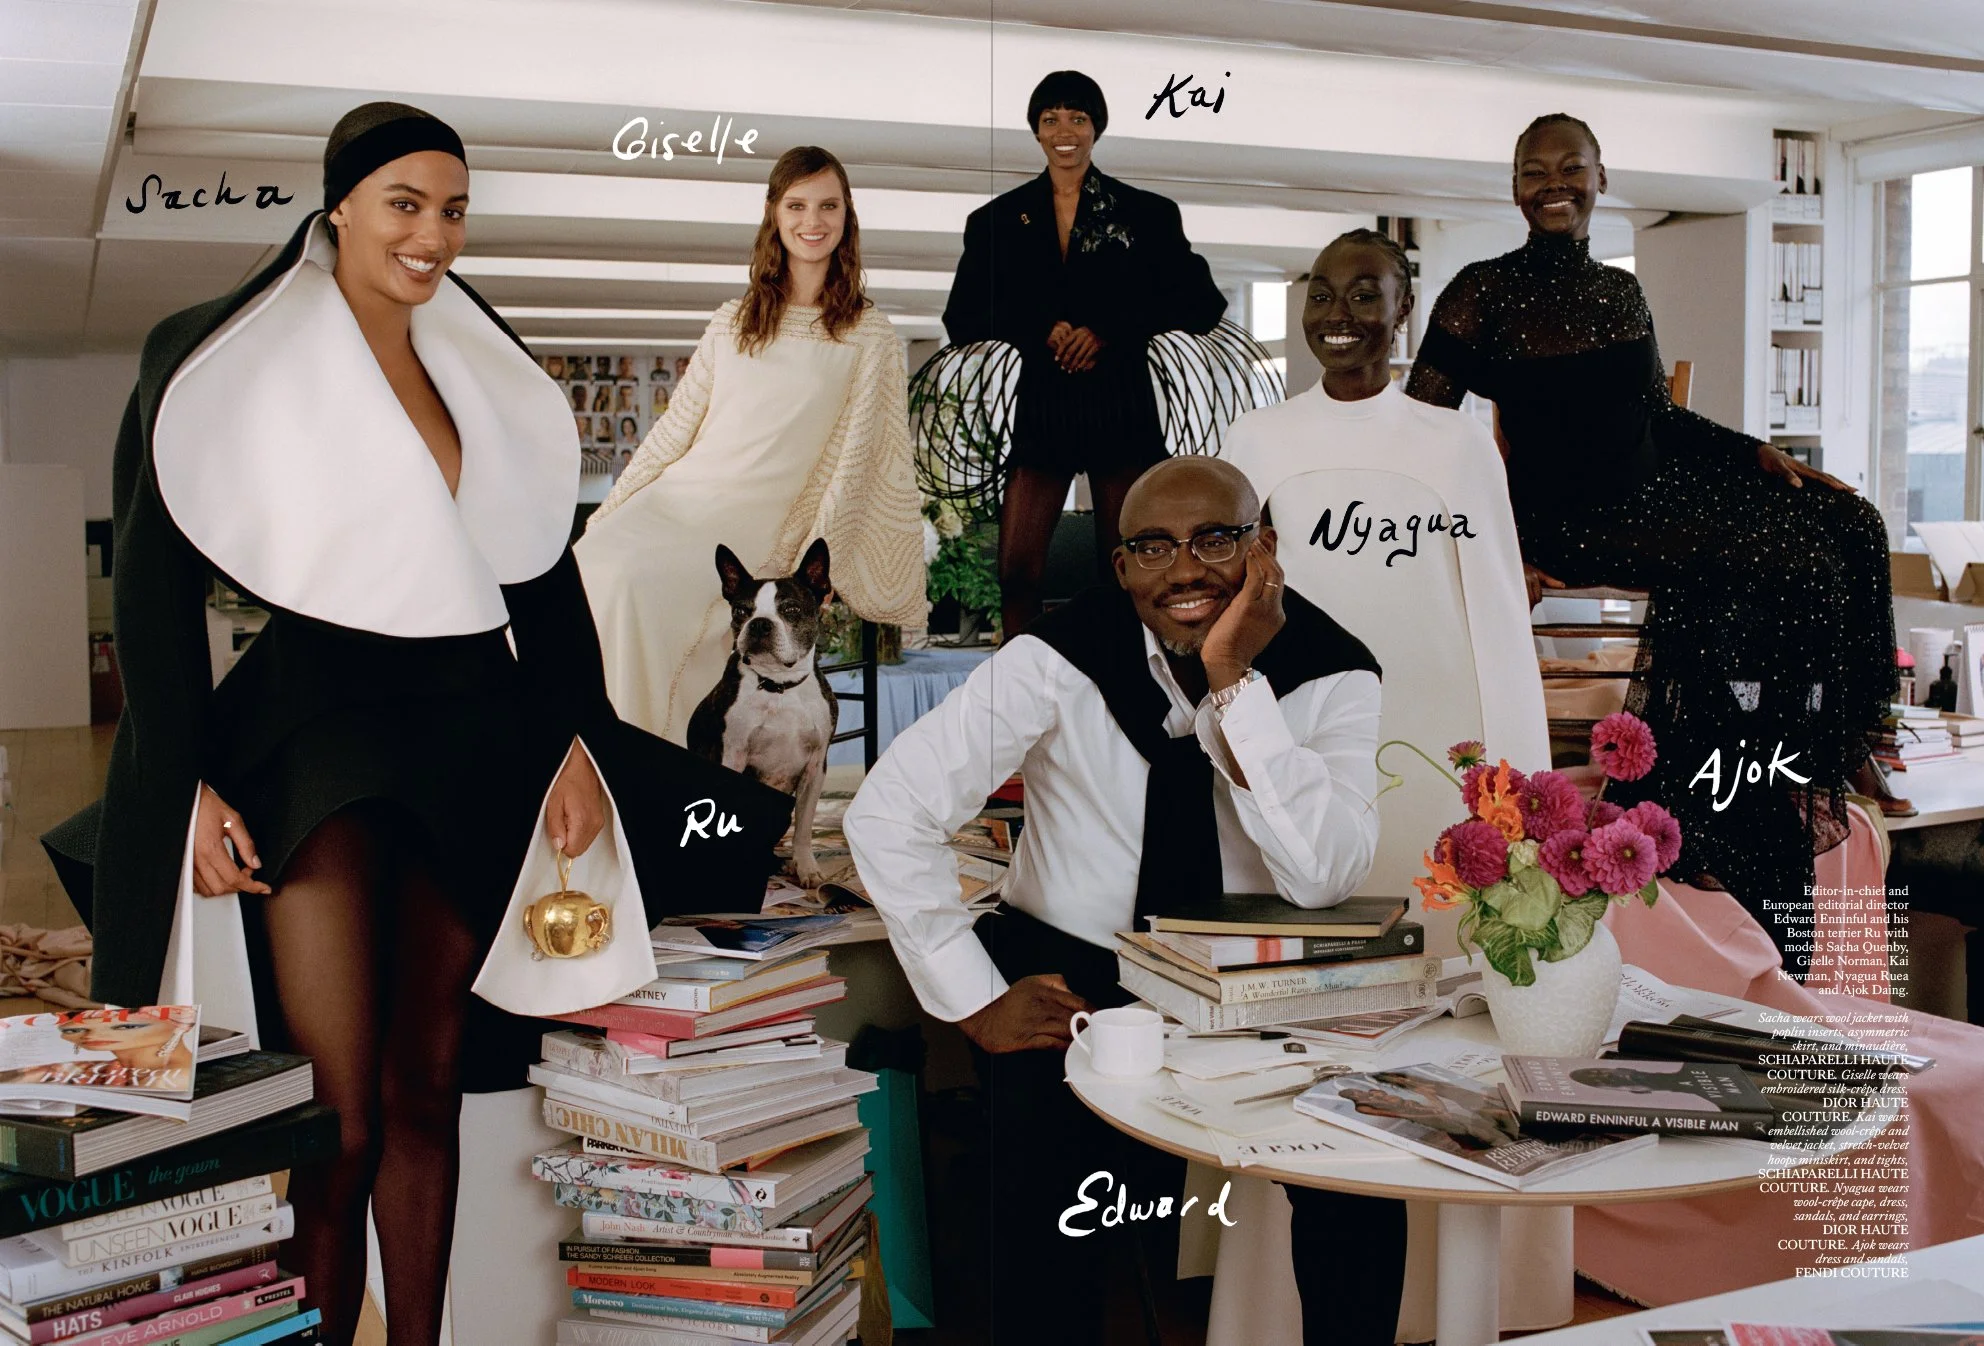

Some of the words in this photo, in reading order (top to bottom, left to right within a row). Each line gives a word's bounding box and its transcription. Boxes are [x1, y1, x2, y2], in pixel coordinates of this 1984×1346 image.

[1253, 988, 1288, 998] Wonderful
[1272, 978, 1307, 988] TURNER
[1716, 1076, 1742, 1095] MAN
[556, 1107, 610, 1138] CHIC
[1536, 1111, 1585, 1123] EDWARD
[1590, 1114, 1648, 1127] ENNINFUL
[1651, 1116, 1661, 1127] A
[1665, 1117, 1706, 1129] VISIBLE
[1710, 1120, 1739, 1131] MAN
[615, 1121, 688, 1160] MILAN
[20, 1171, 135, 1222] VOGUE
[148, 1165, 172, 1184] the
[175, 1158, 220, 1184] gown
[76, 1223, 166, 1263] UNSEEN
[168, 1205, 242, 1239] VOGUE
[600, 1220, 620, 1232] John
[624, 1222, 645, 1232] Nash
[652, 1225, 674, 1233] Artist
[676, 1226, 685, 1234] &
[688, 1228, 732, 1239] Countryman
[102, 1247, 173, 1273] KINFOLK
[180, 1233, 240, 1252] ENTREPRENEUR
[588, 1277, 627, 1288] MODERN
[631, 1281, 656, 1290] LOOK
[42, 1307, 64, 1317] THE
[67, 1291, 113, 1309] NATURAL
[54, 1312, 101, 1339] HATS
[174, 1290, 194, 1303] CLAIR
[195, 1284, 221, 1297] HUGHES
[583, 1294, 624, 1307] Morocco
[102, 1330, 138, 1346] EVE
[144, 1306, 223, 1338] ARNOLD
[265, 1290, 292, 1301] PRESTEL
